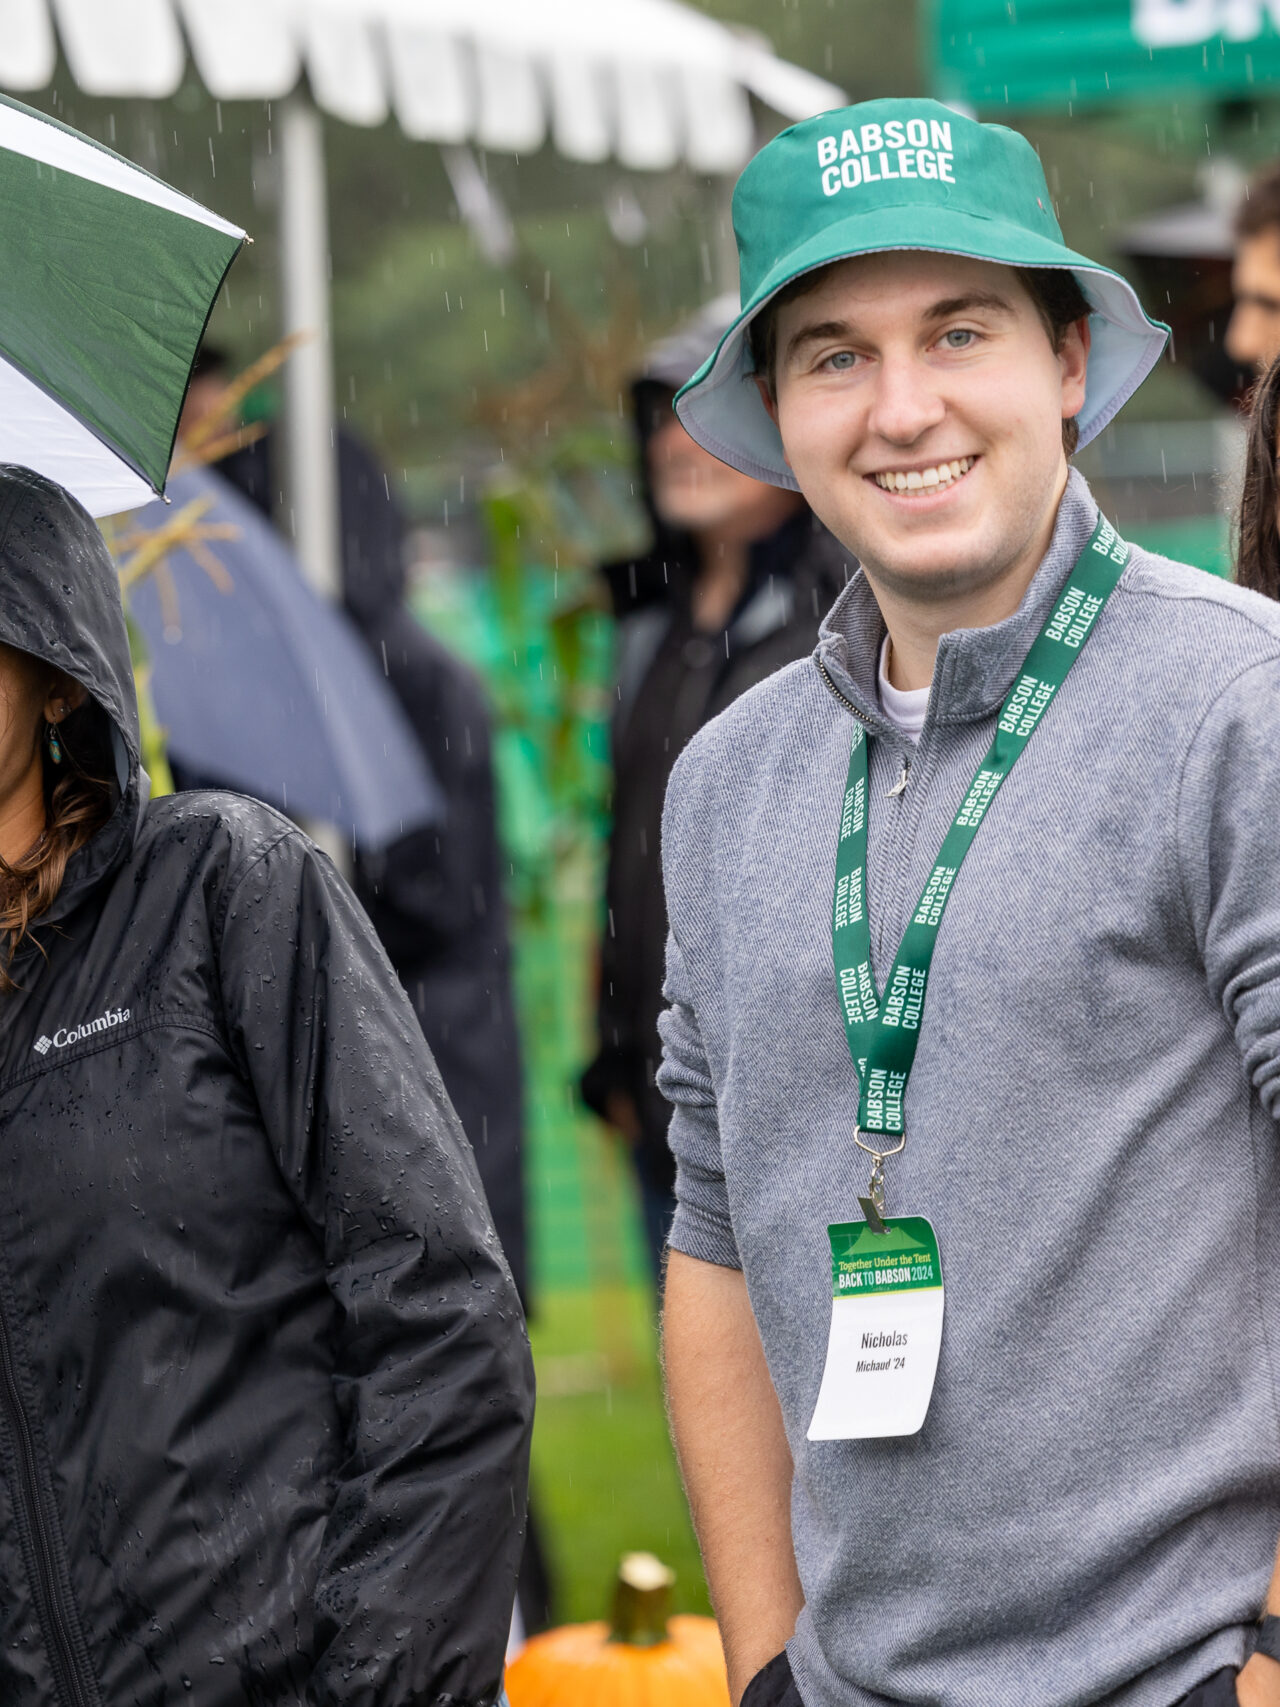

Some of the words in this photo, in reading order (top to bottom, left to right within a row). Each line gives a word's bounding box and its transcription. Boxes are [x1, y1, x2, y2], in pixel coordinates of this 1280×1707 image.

[817, 118, 953, 168] BABSON
[821, 149, 956, 197] COLLEGE
[1045, 586, 1086, 642] BABSON
[1064, 594, 1104, 648] COLLEGE
[998, 674, 1038, 734] BABSON
[1016, 681, 1056, 737] COLLEGE
[840, 787, 855, 842] COLLEGE
[852, 776, 865, 834] BABSON
[956, 770, 993, 826] BABSON
[968, 772, 1004, 826] COLLEGE
[835, 874, 850, 931] COLLEGE
[849, 866, 863, 924] BABSON
[914, 866, 946, 925] BABSON
[928, 867, 957, 926] COLLEGE
[840, 968, 864, 1025] COLLEGE
[858, 961, 879, 1021] BABSON
[882, 965, 911, 1027] BABSON
[902, 968, 926, 1030] COLLEGE
[53, 1008, 131, 1048] Columbia
[866, 1068, 888, 1130] BABSON
[886, 1070, 906, 1131] COLLEGE
[838, 1259, 872, 1272] Together
[874, 1256, 898, 1267] Under
[900, 1254, 912, 1264] the
[914, 1253, 931, 1264] Tent
[838, 1272, 863, 1289] BACK
[863, 1271, 874, 1286] TO
[875, 1267, 911, 1284] BABSON
[912, 1265, 934, 1280] 2024
[856, 1358, 891, 1373] Michaud
[893, 1356, 906, 1370] '24
[861, 1330, 908, 1349] Nicholas
